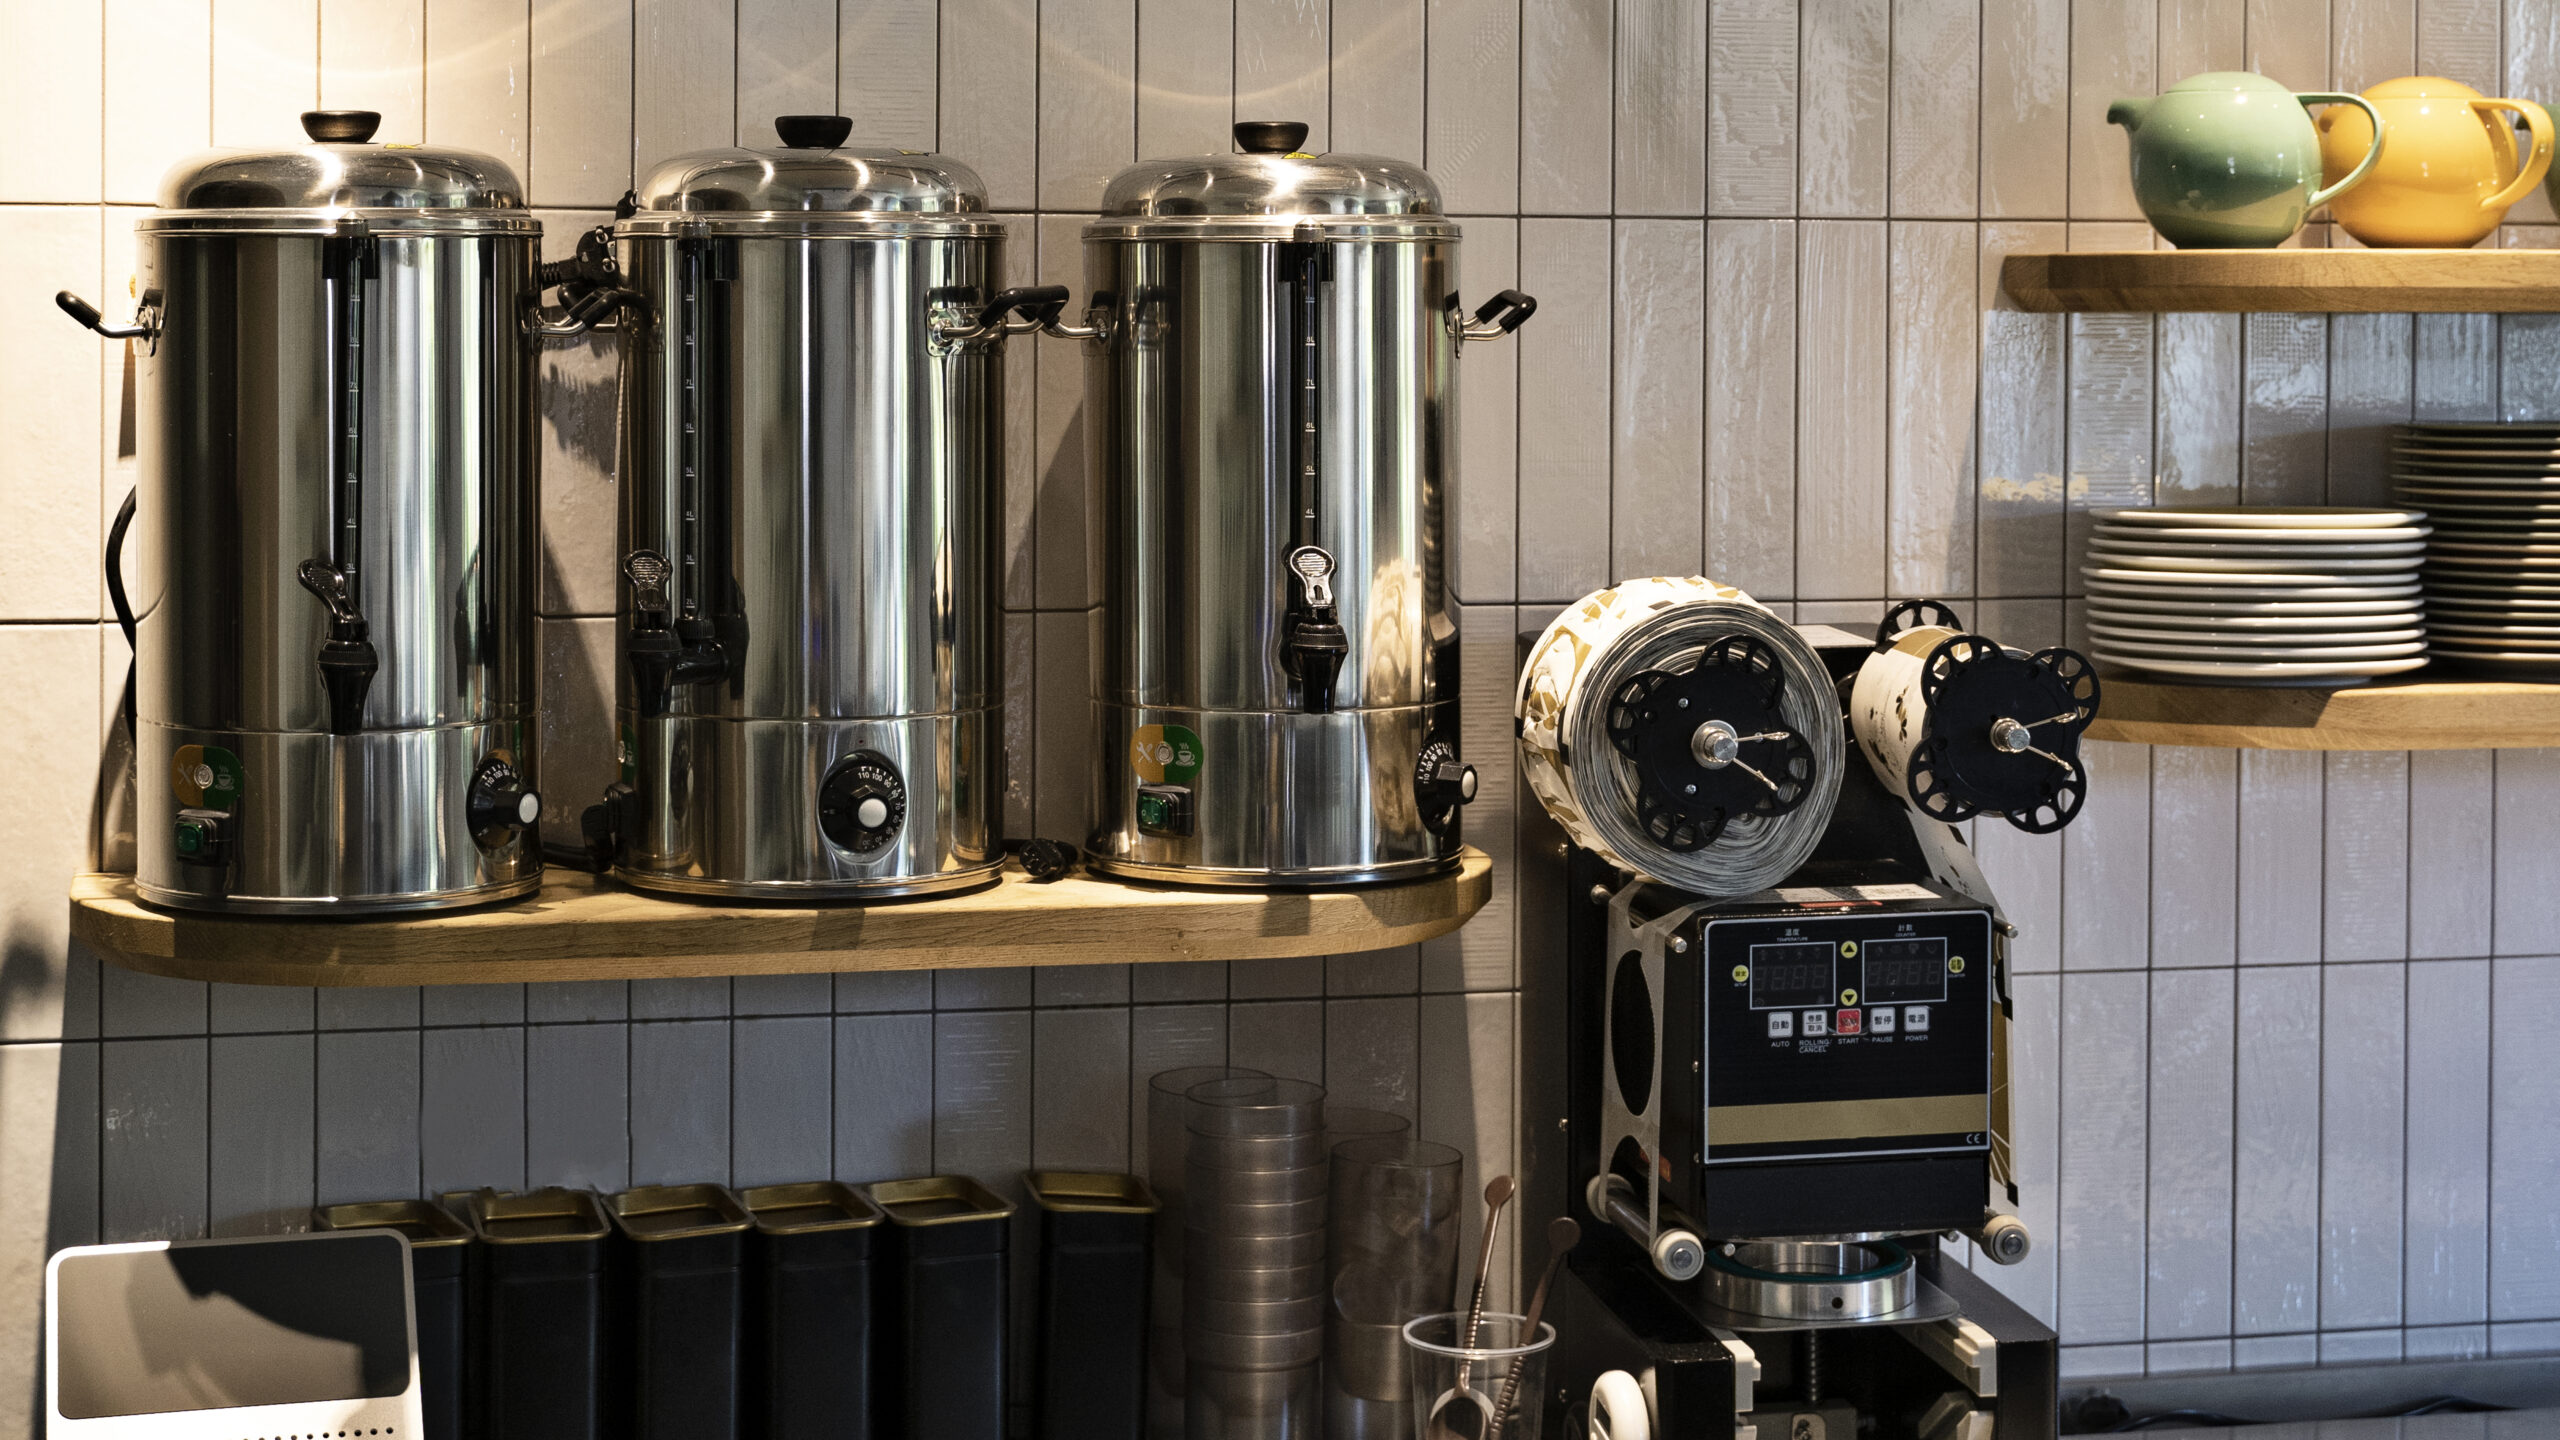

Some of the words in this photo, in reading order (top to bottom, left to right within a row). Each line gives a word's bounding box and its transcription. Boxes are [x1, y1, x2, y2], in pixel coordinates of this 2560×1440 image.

[858, 771, 870, 780] 110
[872, 772, 883, 782] 100
[484, 776, 494, 788] 110
[1874, 1016, 1892, 1024] 暫停
[1908, 1014, 1926, 1023] 電源
[1772, 1020, 1790, 1030] 自動
[1808, 1024, 1822, 1032] 取消
[1799, 1045, 1828, 1053] CANCEL
[1966, 1133, 1980, 1144] CE
